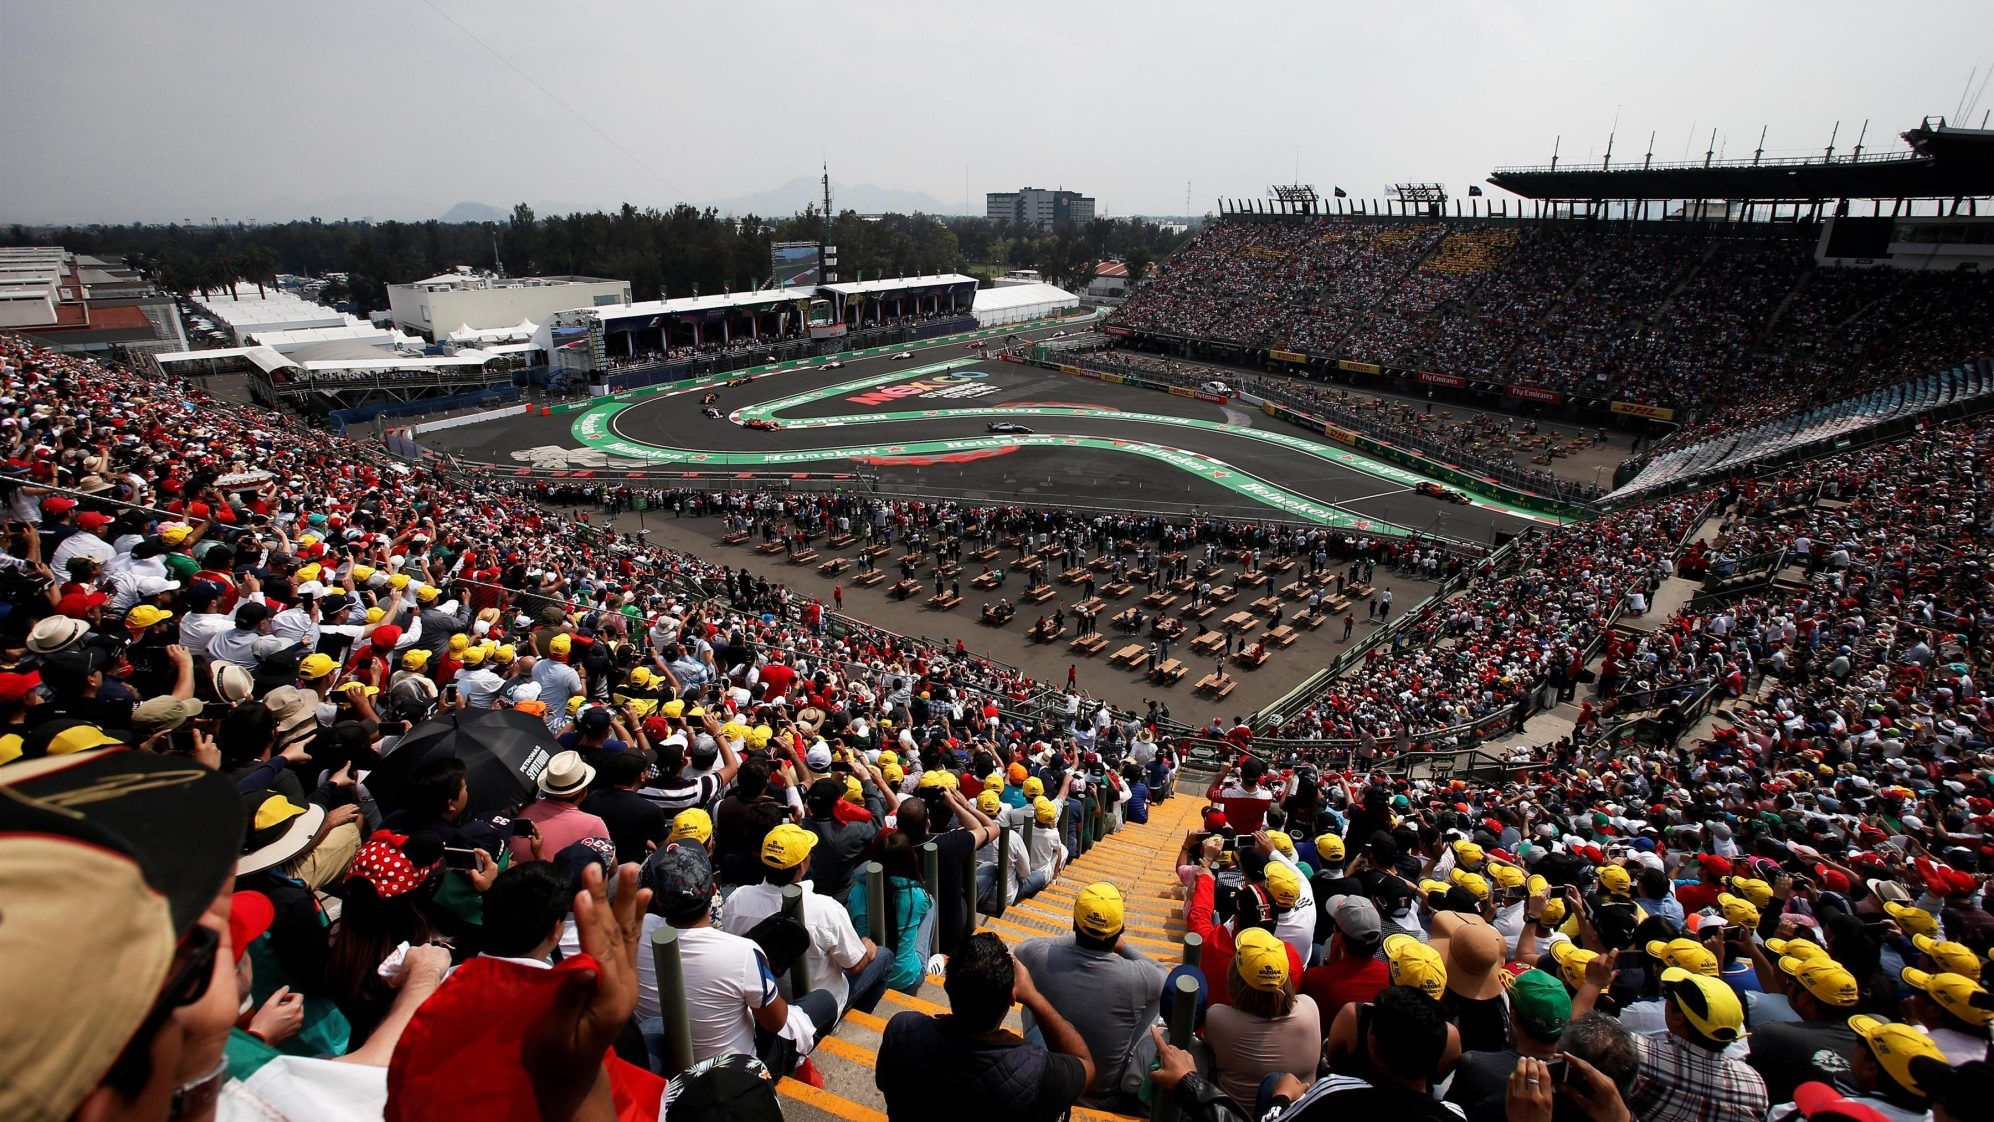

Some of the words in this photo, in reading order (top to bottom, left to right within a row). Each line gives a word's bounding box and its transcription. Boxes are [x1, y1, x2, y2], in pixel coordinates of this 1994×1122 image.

[1422, 374, 1432, 383] Fly
[1432, 375, 1458, 385] Emirates
[1512, 388, 1523, 397] Fly
[1524, 389, 1553, 400] Emirates
[946, 406, 1042, 416] Heineken
[1095, 409, 1190, 424] Heineken
[1621, 404, 1658, 416] DHL
[789, 414, 888, 426] Heineken
[1240, 427, 1325, 451] Heineken
[1329, 429, 1351, 443] DHL
[944, 437, 1054, 449] Heineken
[604, 442, 684, 461] Heineken
[762, 447, 877, 463] Heineken
[1124, 442, 1208, 471] Heineken
[1240, 482, 1340, 520] Heineken
[1511, 499, 1530, 508] ROLEX
[520, 745, 541, 773] PETRONAS
[526, 750, 550, 780] SYNTIUM
[492, 815, 510, 826] 33
[593, 840, 613, 852] 33
